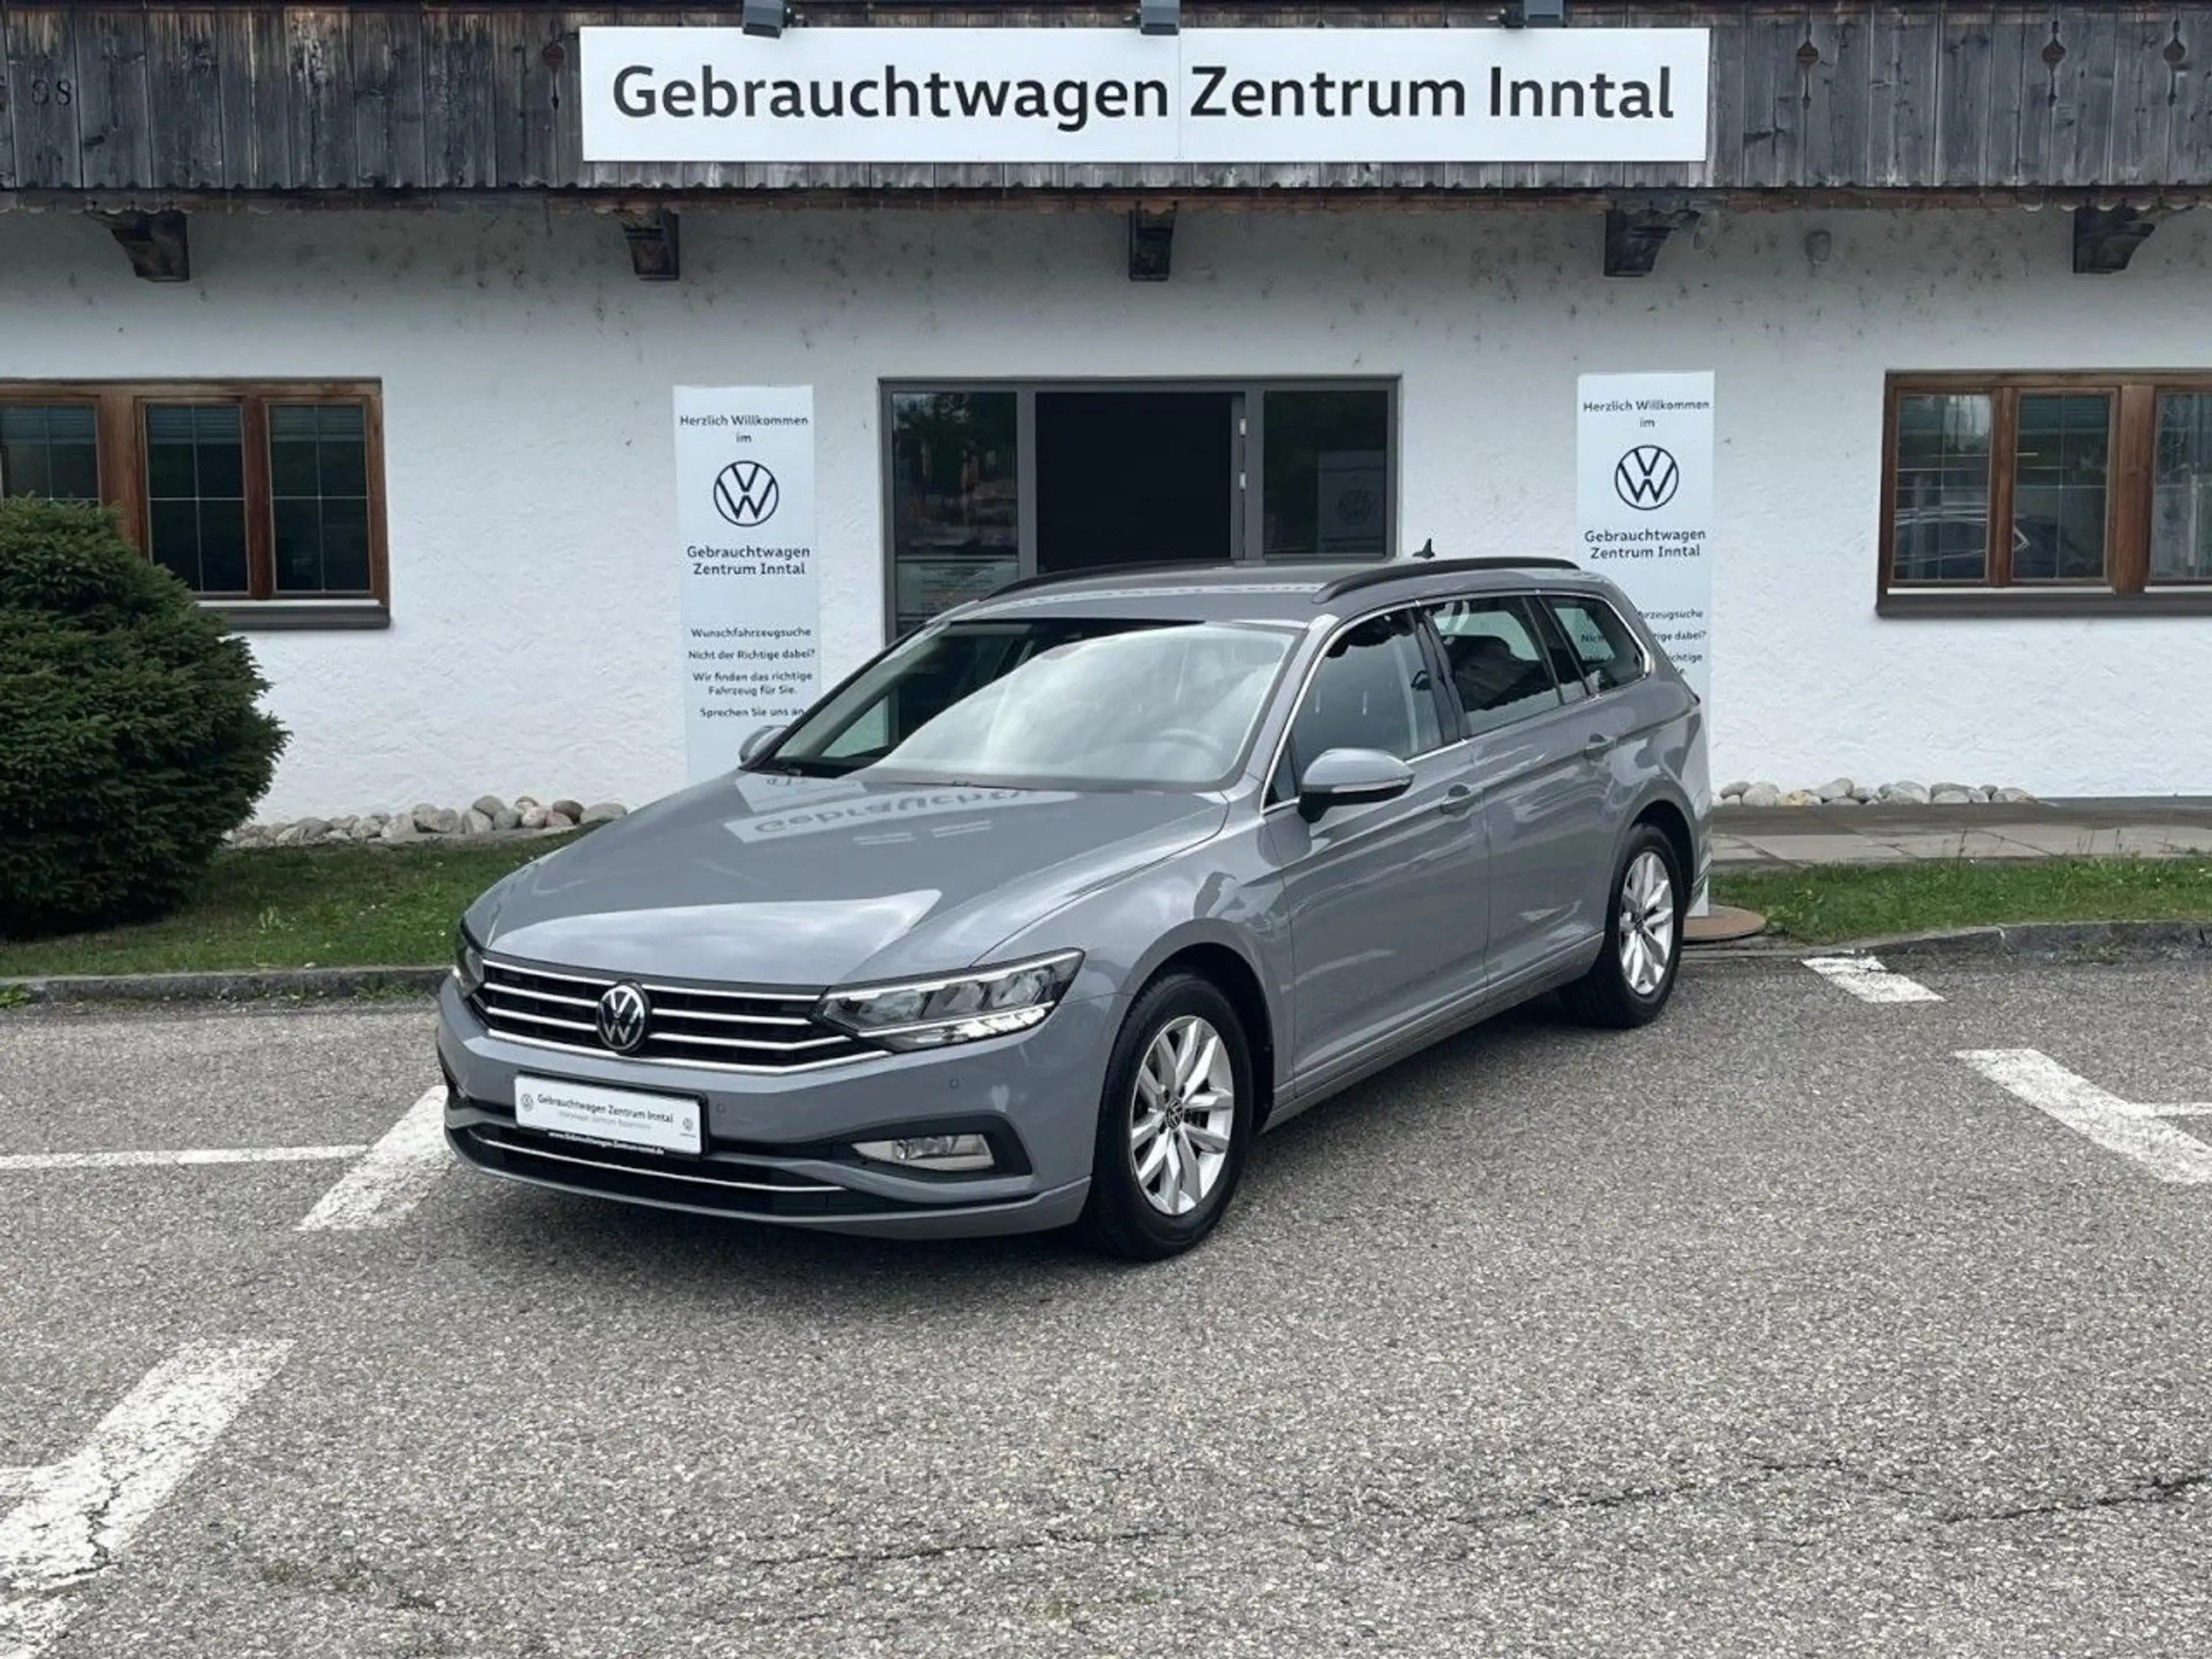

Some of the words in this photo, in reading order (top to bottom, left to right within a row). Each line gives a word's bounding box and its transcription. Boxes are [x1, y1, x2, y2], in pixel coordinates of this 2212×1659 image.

[613, 65, 1168, 132] Gebrauchtwagen
[1190, 66, 1465, 118] Zentrum
[1490, 66, 1674, 119] Inntal
[1582, 399, 1633, 413] Herzlich
[1634, 399, 1710, 411] Willkommen
[679, 414, 729, 427] Herzlich
[730, 414, 809, 427] Willkommen
[1639, 418, 1656, 428] im
[736, 431, 753, 444] im
[1584, 527, 1707, 546] Gebrauchtwagen
[686, 544, 810, 562] Gebrauchtwagen
[1589, 546, 1654, 560] Zentrum
[1658, 544, 1701, 558] Inntal
[692, 560, 757, 575] Zentrum
[759, 561, 806, 576] Inntal
[691, 627, 812, 639] Wunschfahrzeugsuche
[687, 650, 715, 660] Nicht
[718, 650, 734, 660] der
[736, 649, 781, 662] Richtige
[781, 648, 816, 660] dabei?
[692, 672, 713, 683] Wir
[714, 671, 748, 683] finden
[749, 671, 770, 682] das
[771, 671, 813, 683] richtige
[707, 685, 758, 698] Fahrzeug
[759, 684, 777, 695] für
[699, 707, 749, 719] Sprechen
[751, 706, 767, 718] Sie
[769, 708, 789, 717] uns
[608, 1104, 645, 1119] Zentrum
